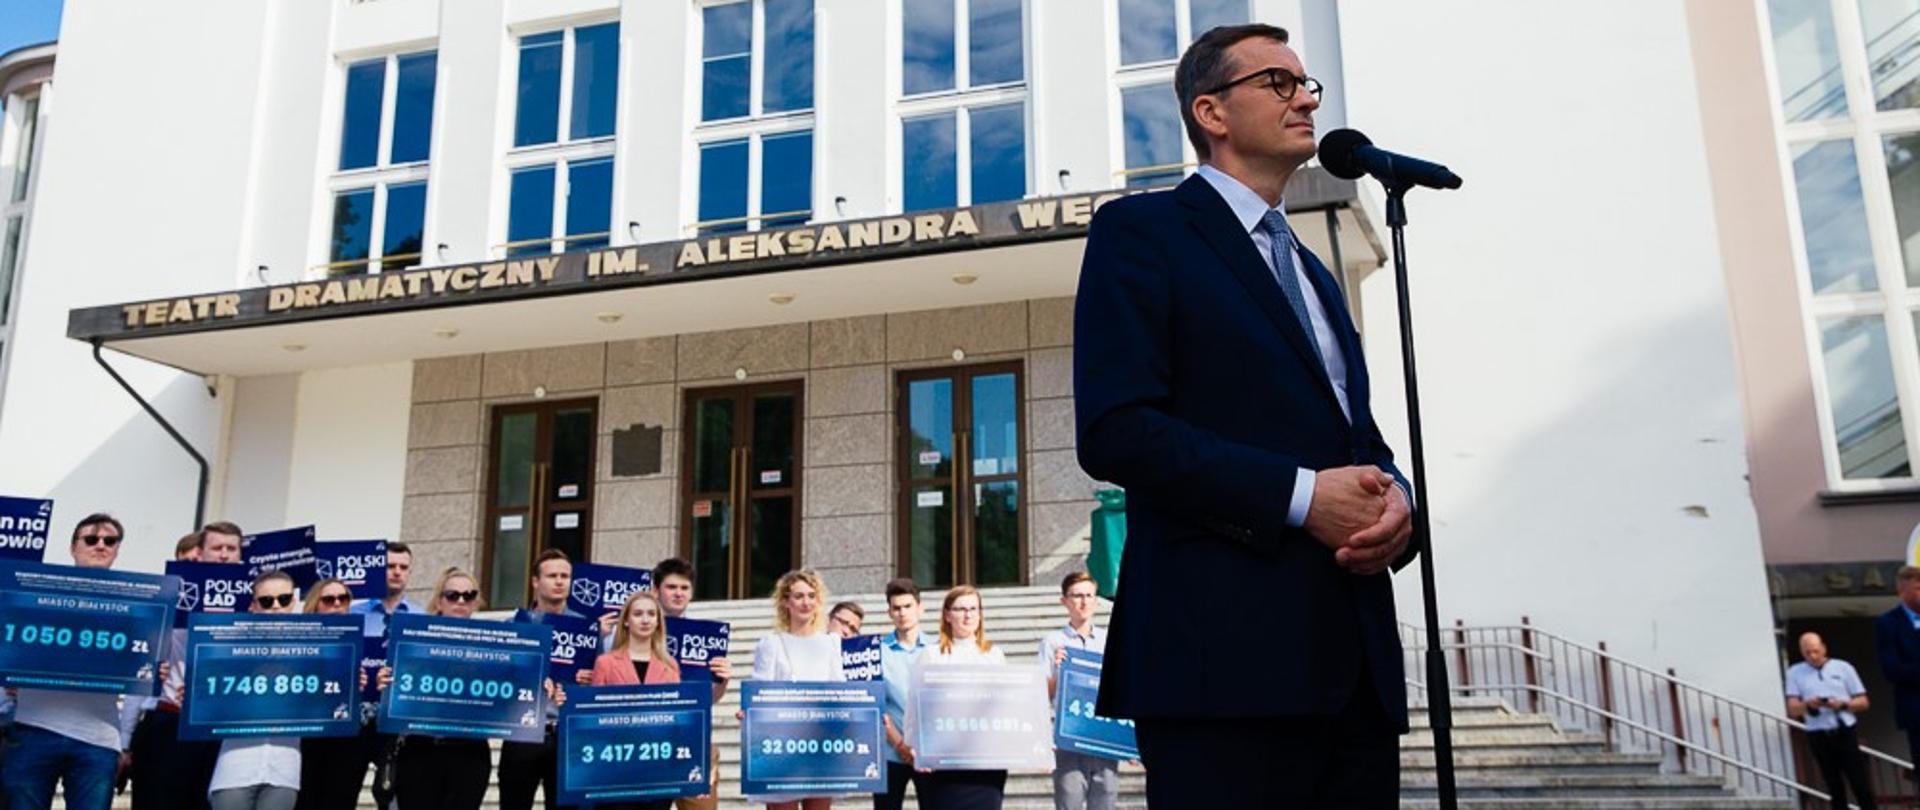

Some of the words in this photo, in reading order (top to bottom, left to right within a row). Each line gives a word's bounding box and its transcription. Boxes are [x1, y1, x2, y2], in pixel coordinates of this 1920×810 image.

[123, 293, 241, 326] TEATR
[268, 256, 560, 311] DRAMATYCZNY
[587, 248, 649, 276] IM.
[677, 209, 980, 268] ALEKSANDRA
[0, 516, 14, 530] n
[18, 516, 46, 531] na
[337, 555, 385, 568] POLSKI
[336, 568, 366, 580] ŁAD
[205, 579, 253, 594] POLSK
[38, 597, 76, 608] MIASTO
[203, 593, 236, 606] ŁAD
[5, 624, 16, 642] 1
[21, 625, 73, 646] 050
[79, 630, 127, 650] 950
[682, 634, 727, 650] POLSKI
[232, 647, 269, 656] MIASTO
[271, 647, 320, 656] BIAŁYSTOK
[430, 647, 464, 658] MIASTO
[551, 645, 576, 658] AD
[681, 647, 709, 660] ŁAD
[844, 661, 881, 681] woju
[207, 676, 216, 694] 1
[223, 675, 268, 695] 746
[274, 674, 319, 694] 869
[400, 673, 413, 692] 3
[419, 674, 464, 695] 800
[470, 679, 514, 699] 000
[598, 716, 630, 725] MIASTO
[581, 745, 594, 763] 3
[600, 743, 634, 762] 417
[639, 742, 672, 761] 219
[762, 739, 783, 754] 32
[786, 739, 819, 754] 000
[822, 739, 855, 754] 000
